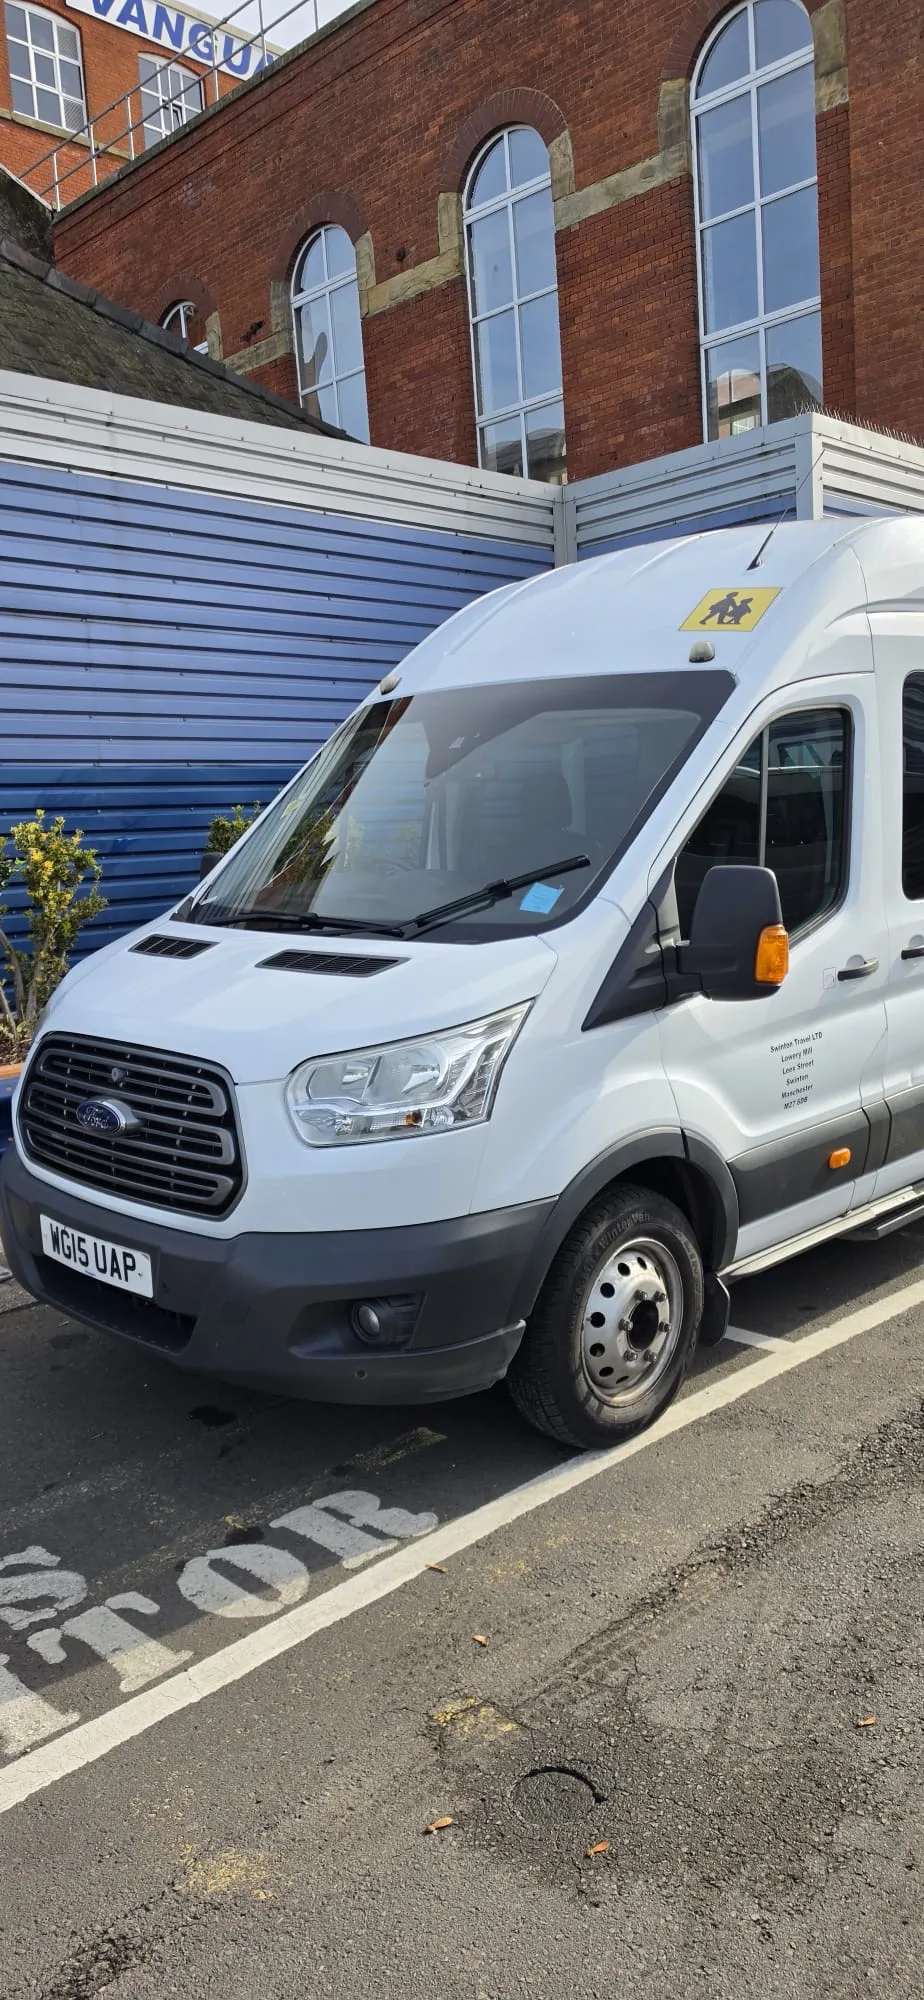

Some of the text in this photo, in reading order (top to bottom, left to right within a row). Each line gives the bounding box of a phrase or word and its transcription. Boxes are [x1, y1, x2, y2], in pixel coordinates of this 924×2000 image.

[770, 1031, 823, 1053] Swinton Travel LTD
[781, 1046, 813, 1062] Lowery Mill
[782, 1059, 814, 1075] Lees Street
[786, 1074, 809, 1086] Swinton
[781, 1084, 813, 1099] Manchester
[783, 1100, 796, 1110] M27
[49, 1222, 136, 1282] WG15 UAP
